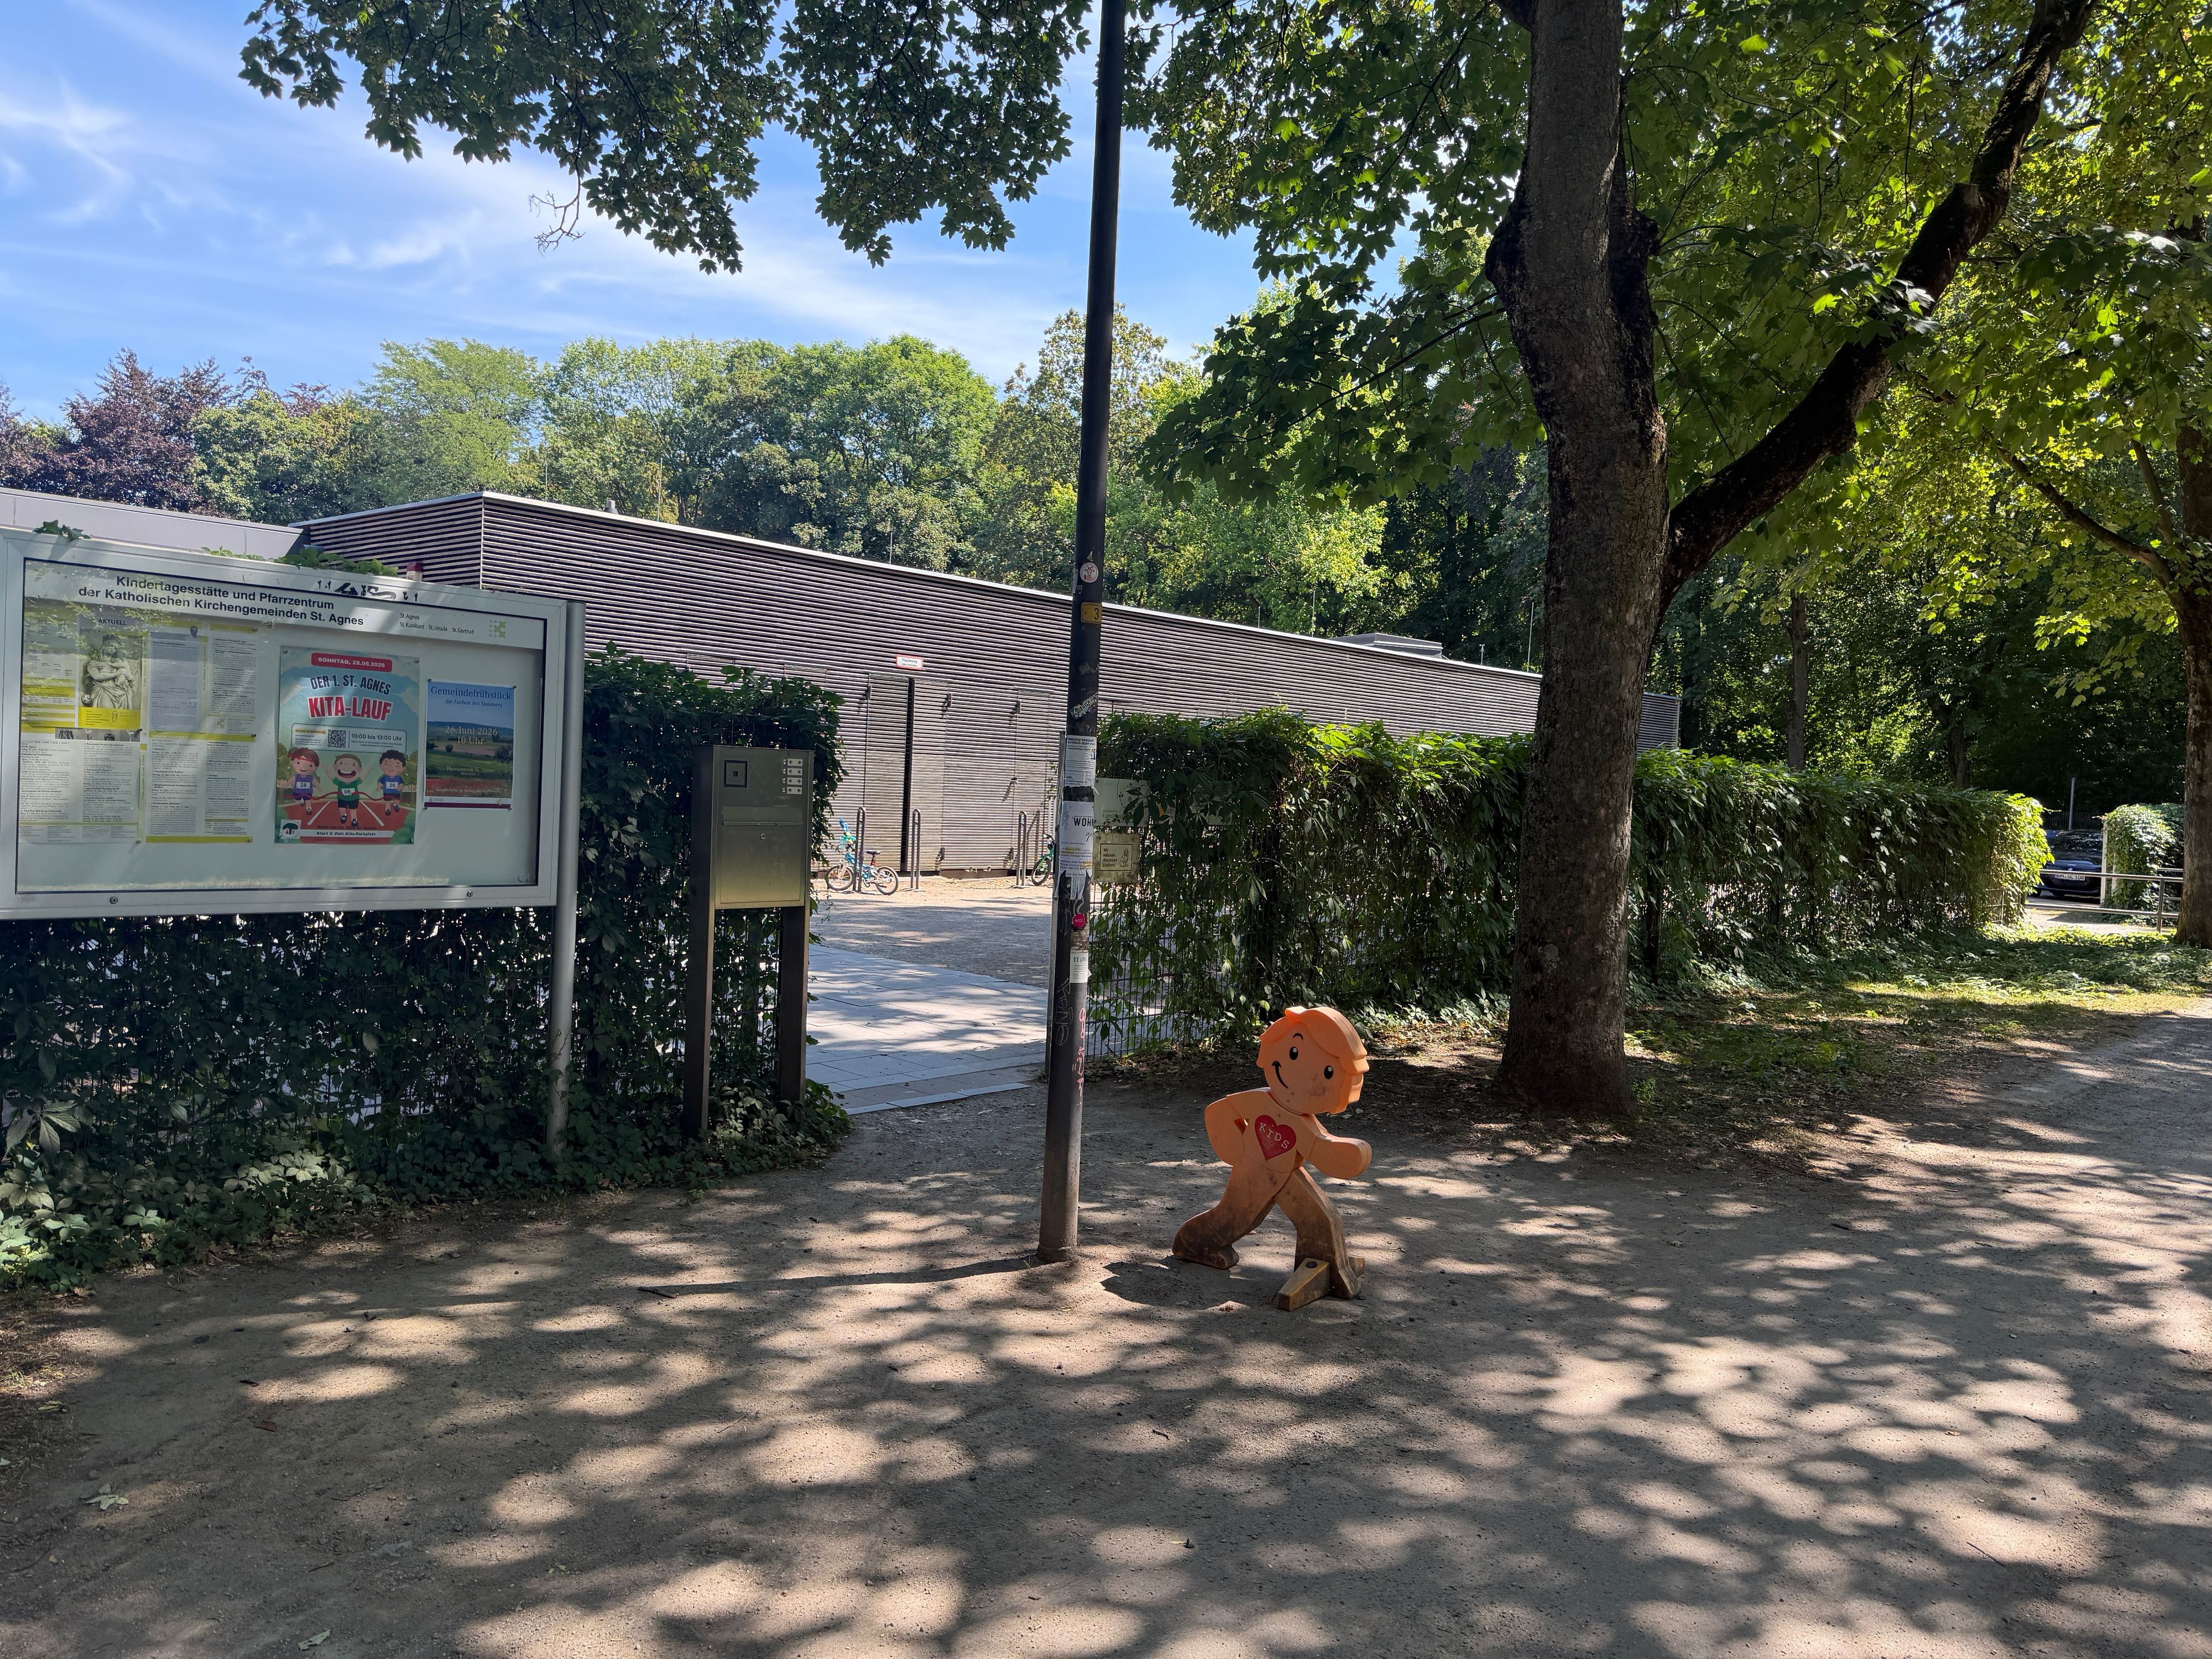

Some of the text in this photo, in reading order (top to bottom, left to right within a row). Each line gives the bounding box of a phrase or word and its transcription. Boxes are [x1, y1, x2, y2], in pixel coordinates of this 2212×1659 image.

[116, 576, 334, 609] Kindertagesstätte und Pfarrzentrum
[79, 587, 364, 625] der Katholischen Kirchengemeinden St. Agnes
[318, 657, 351, 665] SONNTAG,
[310, 675, 392, 695] DER 1. ST. AGNES
[431, 686, 511, 700] Gemeindefrühstück
[308, 696, 393, 721] KITA-LAUF
[469, 737, 484, 745] Uhr
[478, 727, 498, 736] 2026
[1259, 1123, 1289, 1149] KIDS
